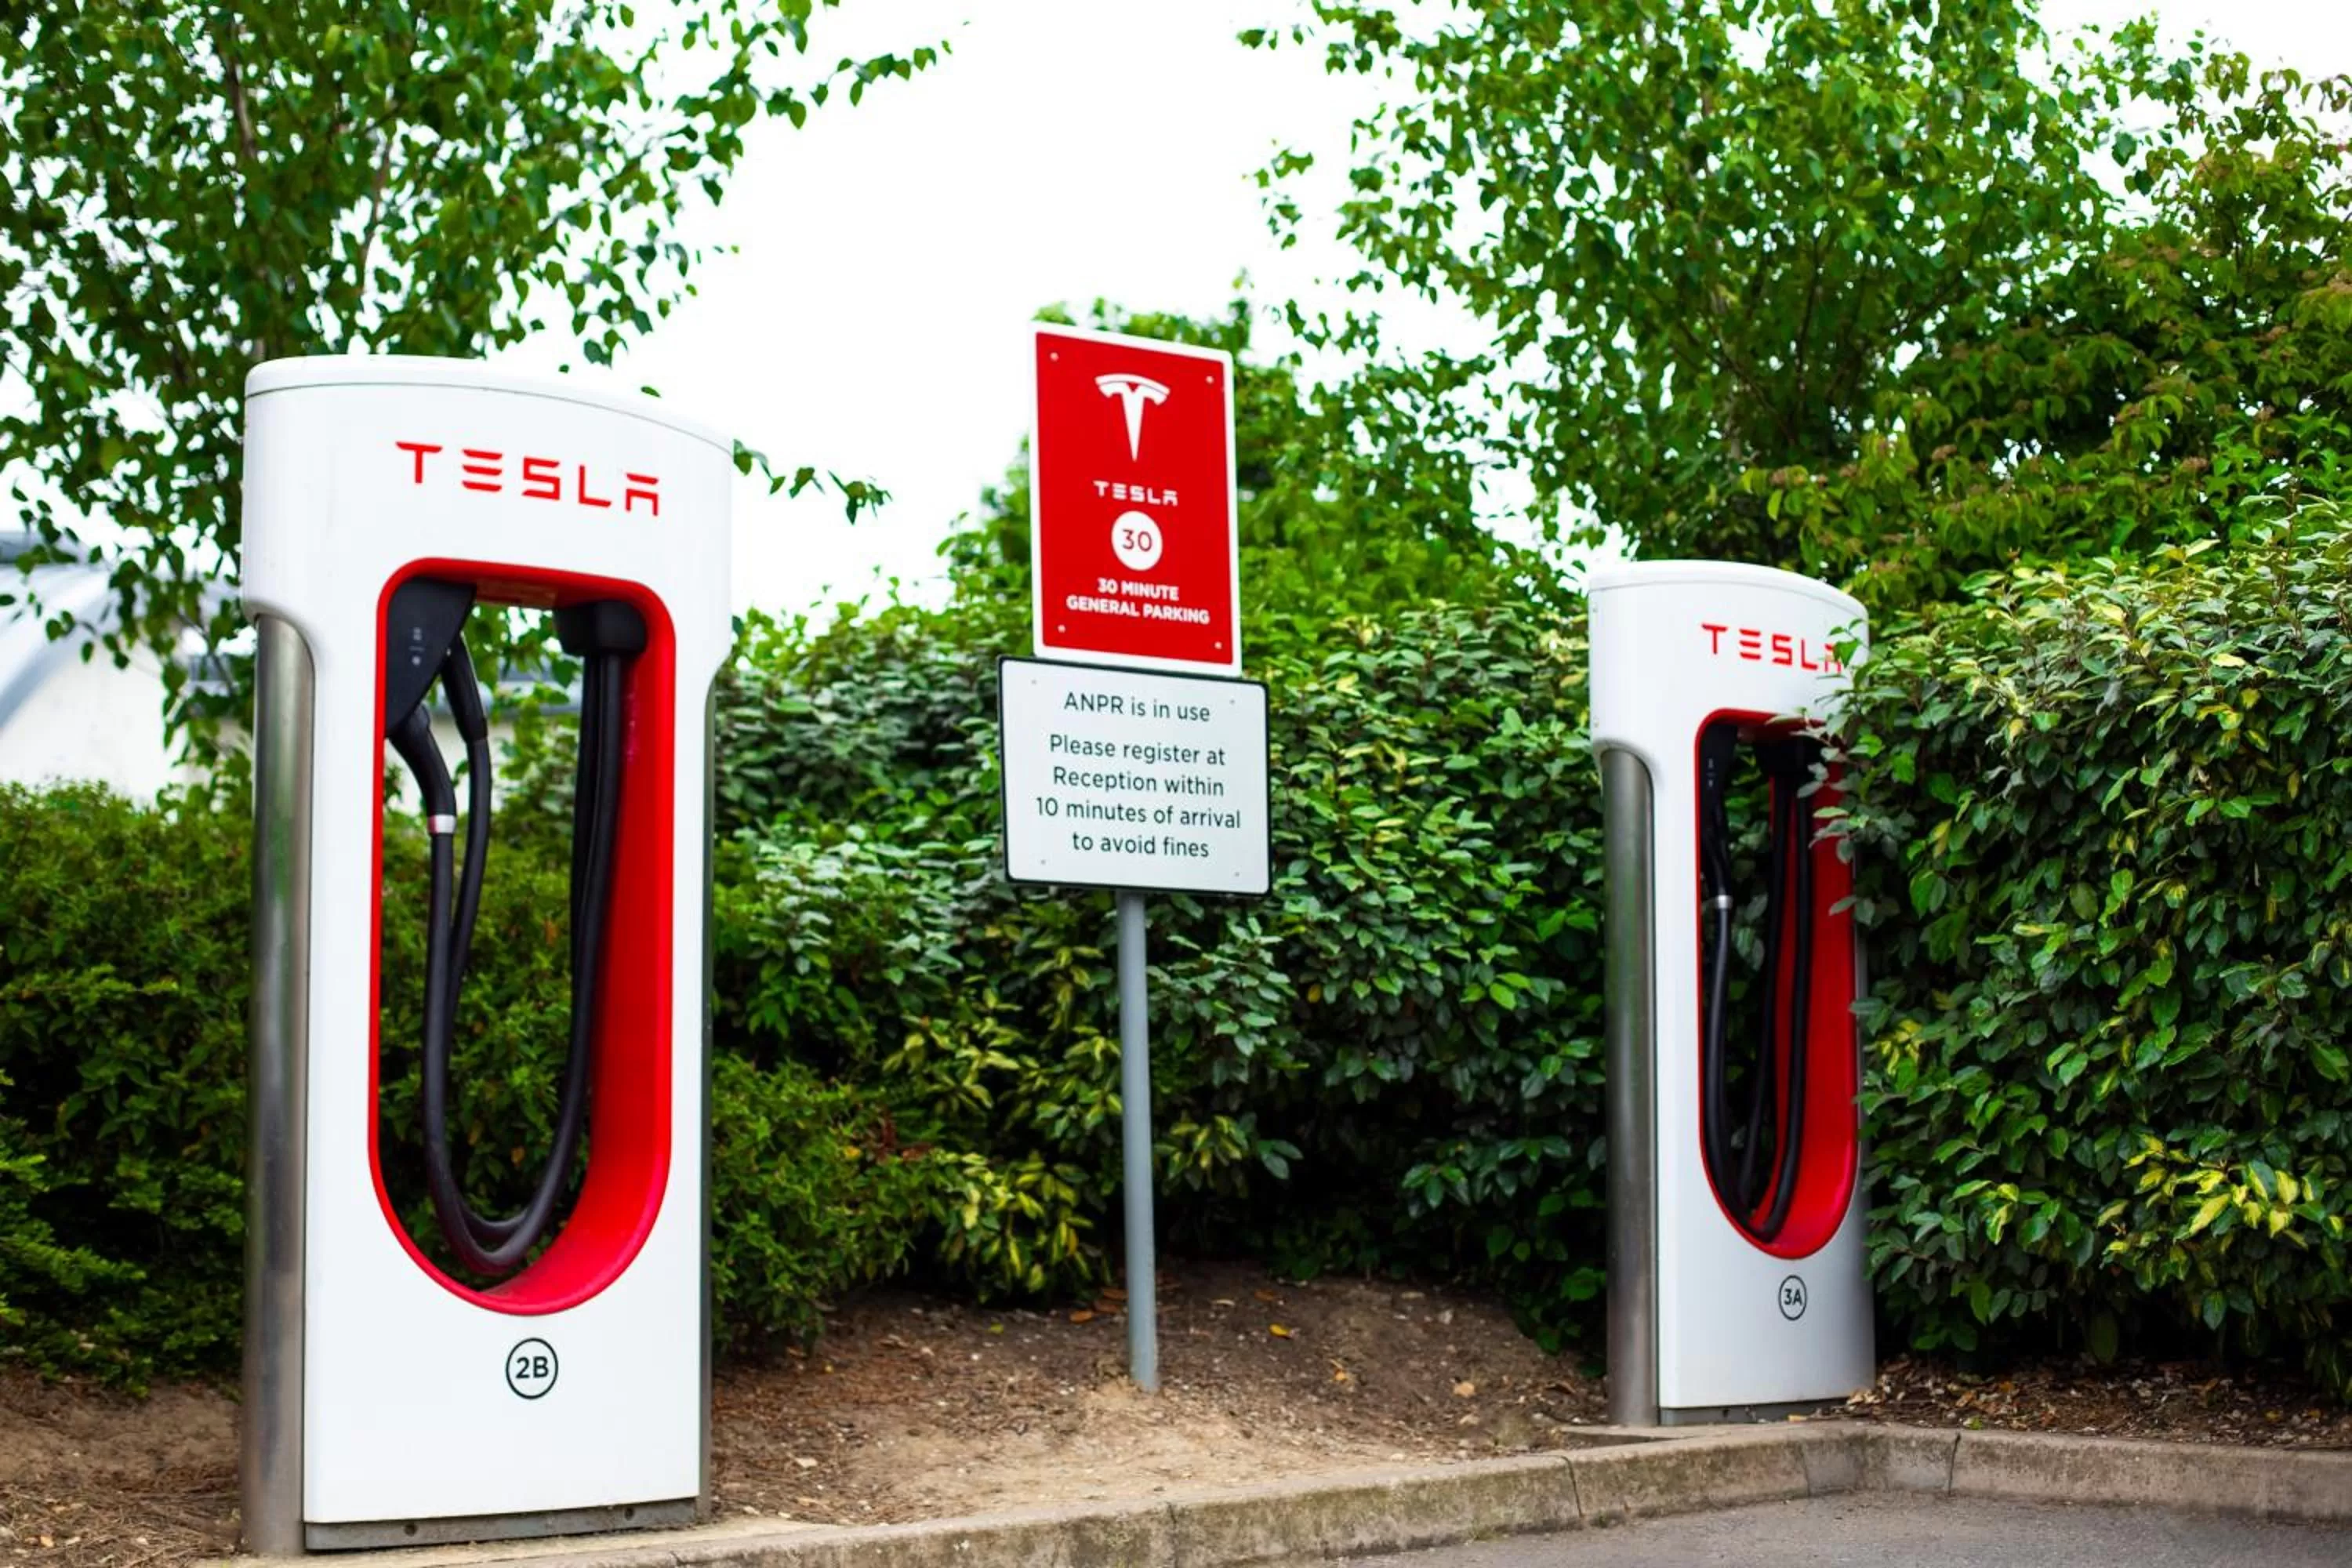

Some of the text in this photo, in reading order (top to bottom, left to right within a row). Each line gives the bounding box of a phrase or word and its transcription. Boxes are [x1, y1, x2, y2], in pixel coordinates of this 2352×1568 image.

[395, 441, 659, 517] TESLA
[1094, 480, 1178, 506] TESLA
[1122, 528, 1152, 552] 30
[1098, 577, 1180, 601] 30 MINUTE
[1066, 594, 1210, 625] GENERAL PARKING
[1064, 691, 1211, 722] ANPR is in use
[1049, 734, 1226, 766] Please register at
[1053, 766, 1225, 797] Reception within
[1036, 797, 1241, 829] 10 minutes of arrival
[1072, 833, 1210, 858] to avoid fines
[1784, 1288, 1802, 1306] 3A
[516, 1356, 550, 1379] 2B
